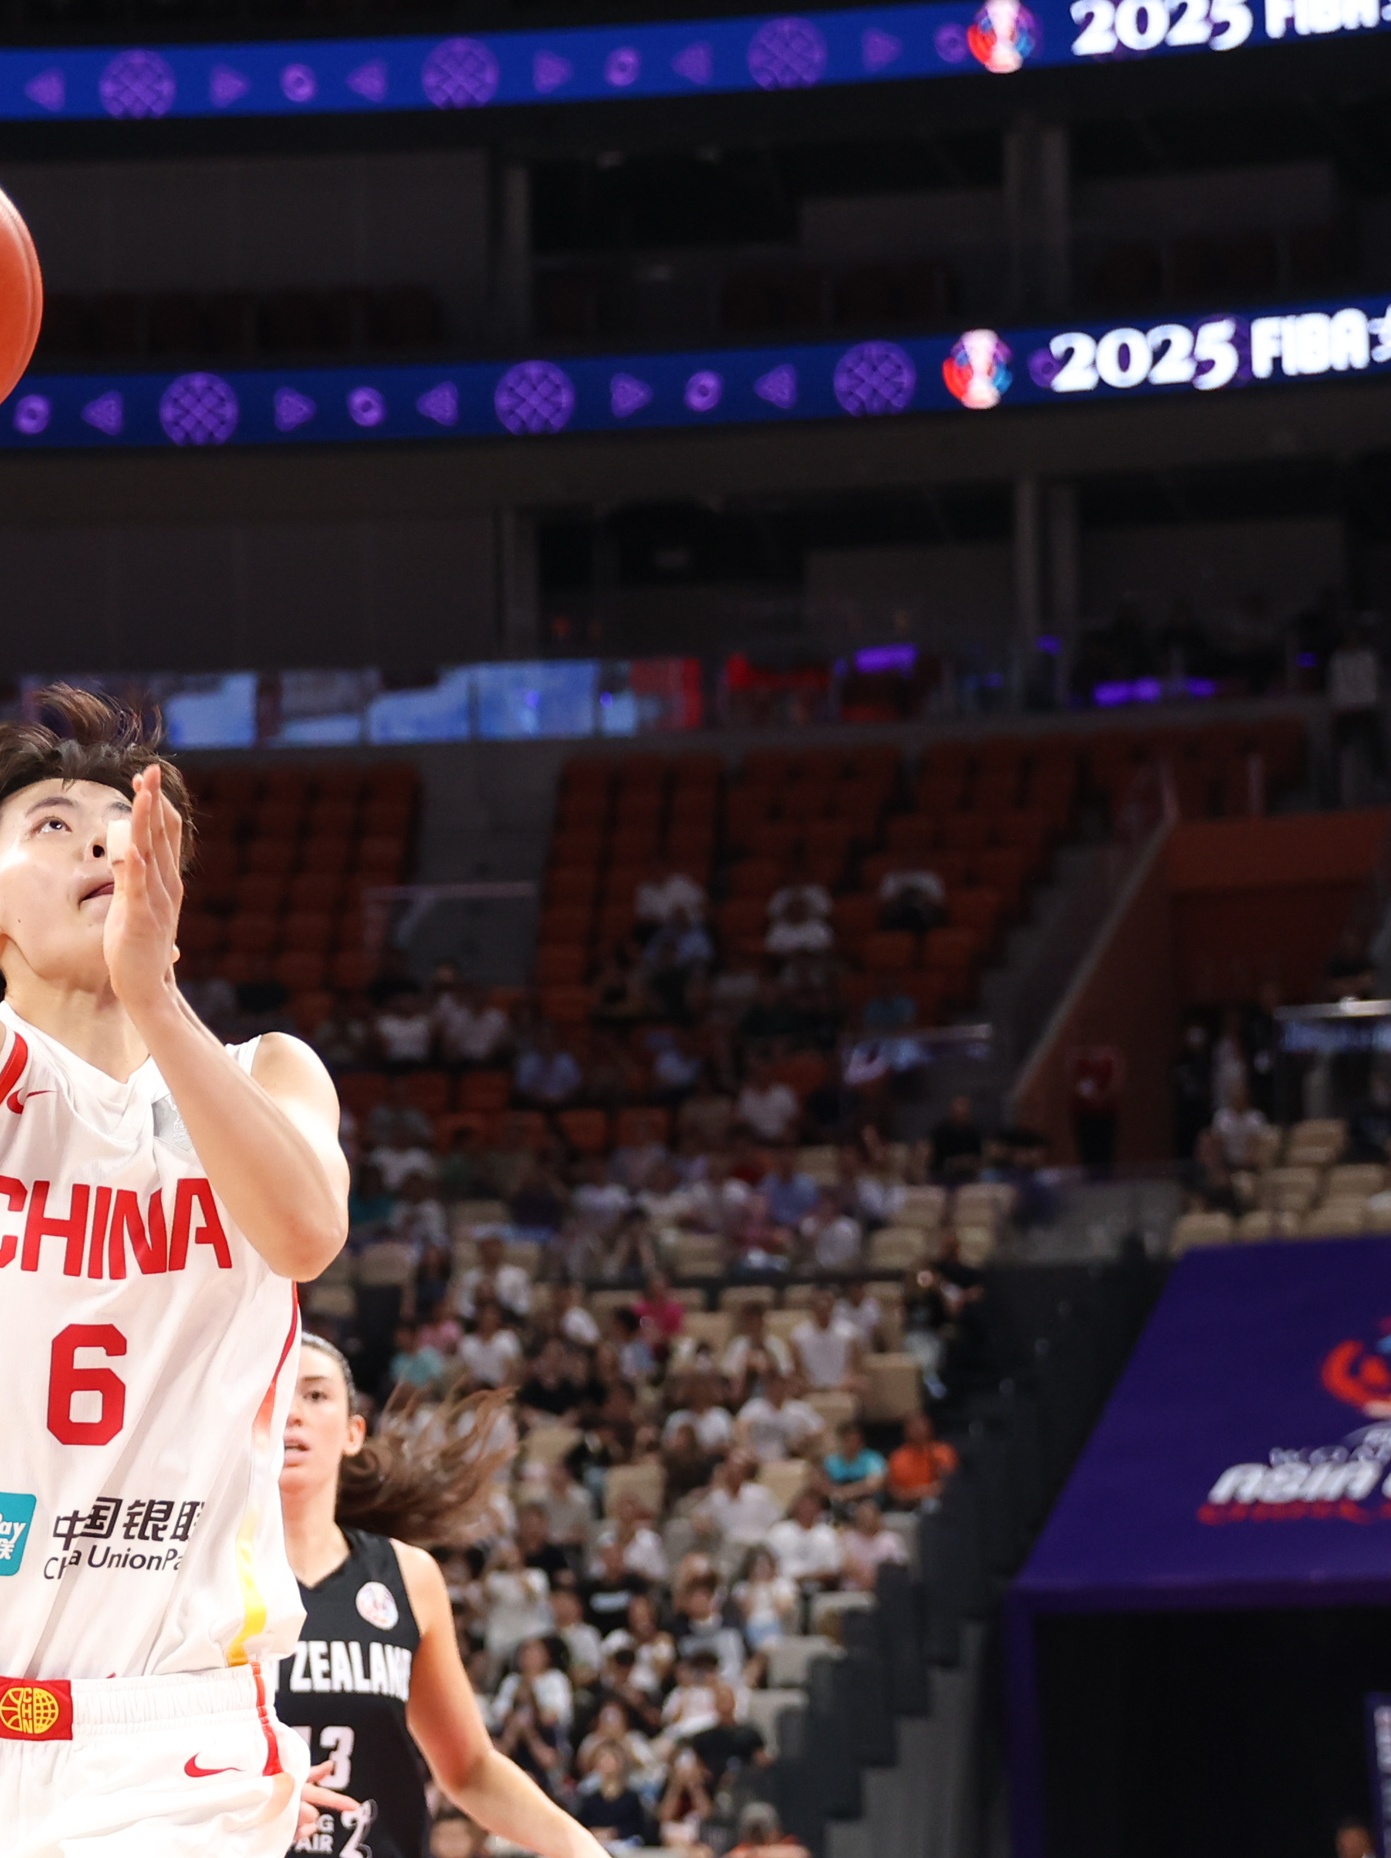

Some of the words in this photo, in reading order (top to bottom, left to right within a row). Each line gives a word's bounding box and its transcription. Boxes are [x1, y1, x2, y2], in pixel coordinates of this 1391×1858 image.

[1070, 0, 1254, 55] 2025
[1049, 317, 1239, 392] 2025
[1251, 307, 1370, 379] FIBA
[47, 1323, 127, 1446] 6
[87, 1544, 183, 1571] UnionPa
[21, 1687, 34, 1734] CHN
[291, 1726, 355, 1791] 3
